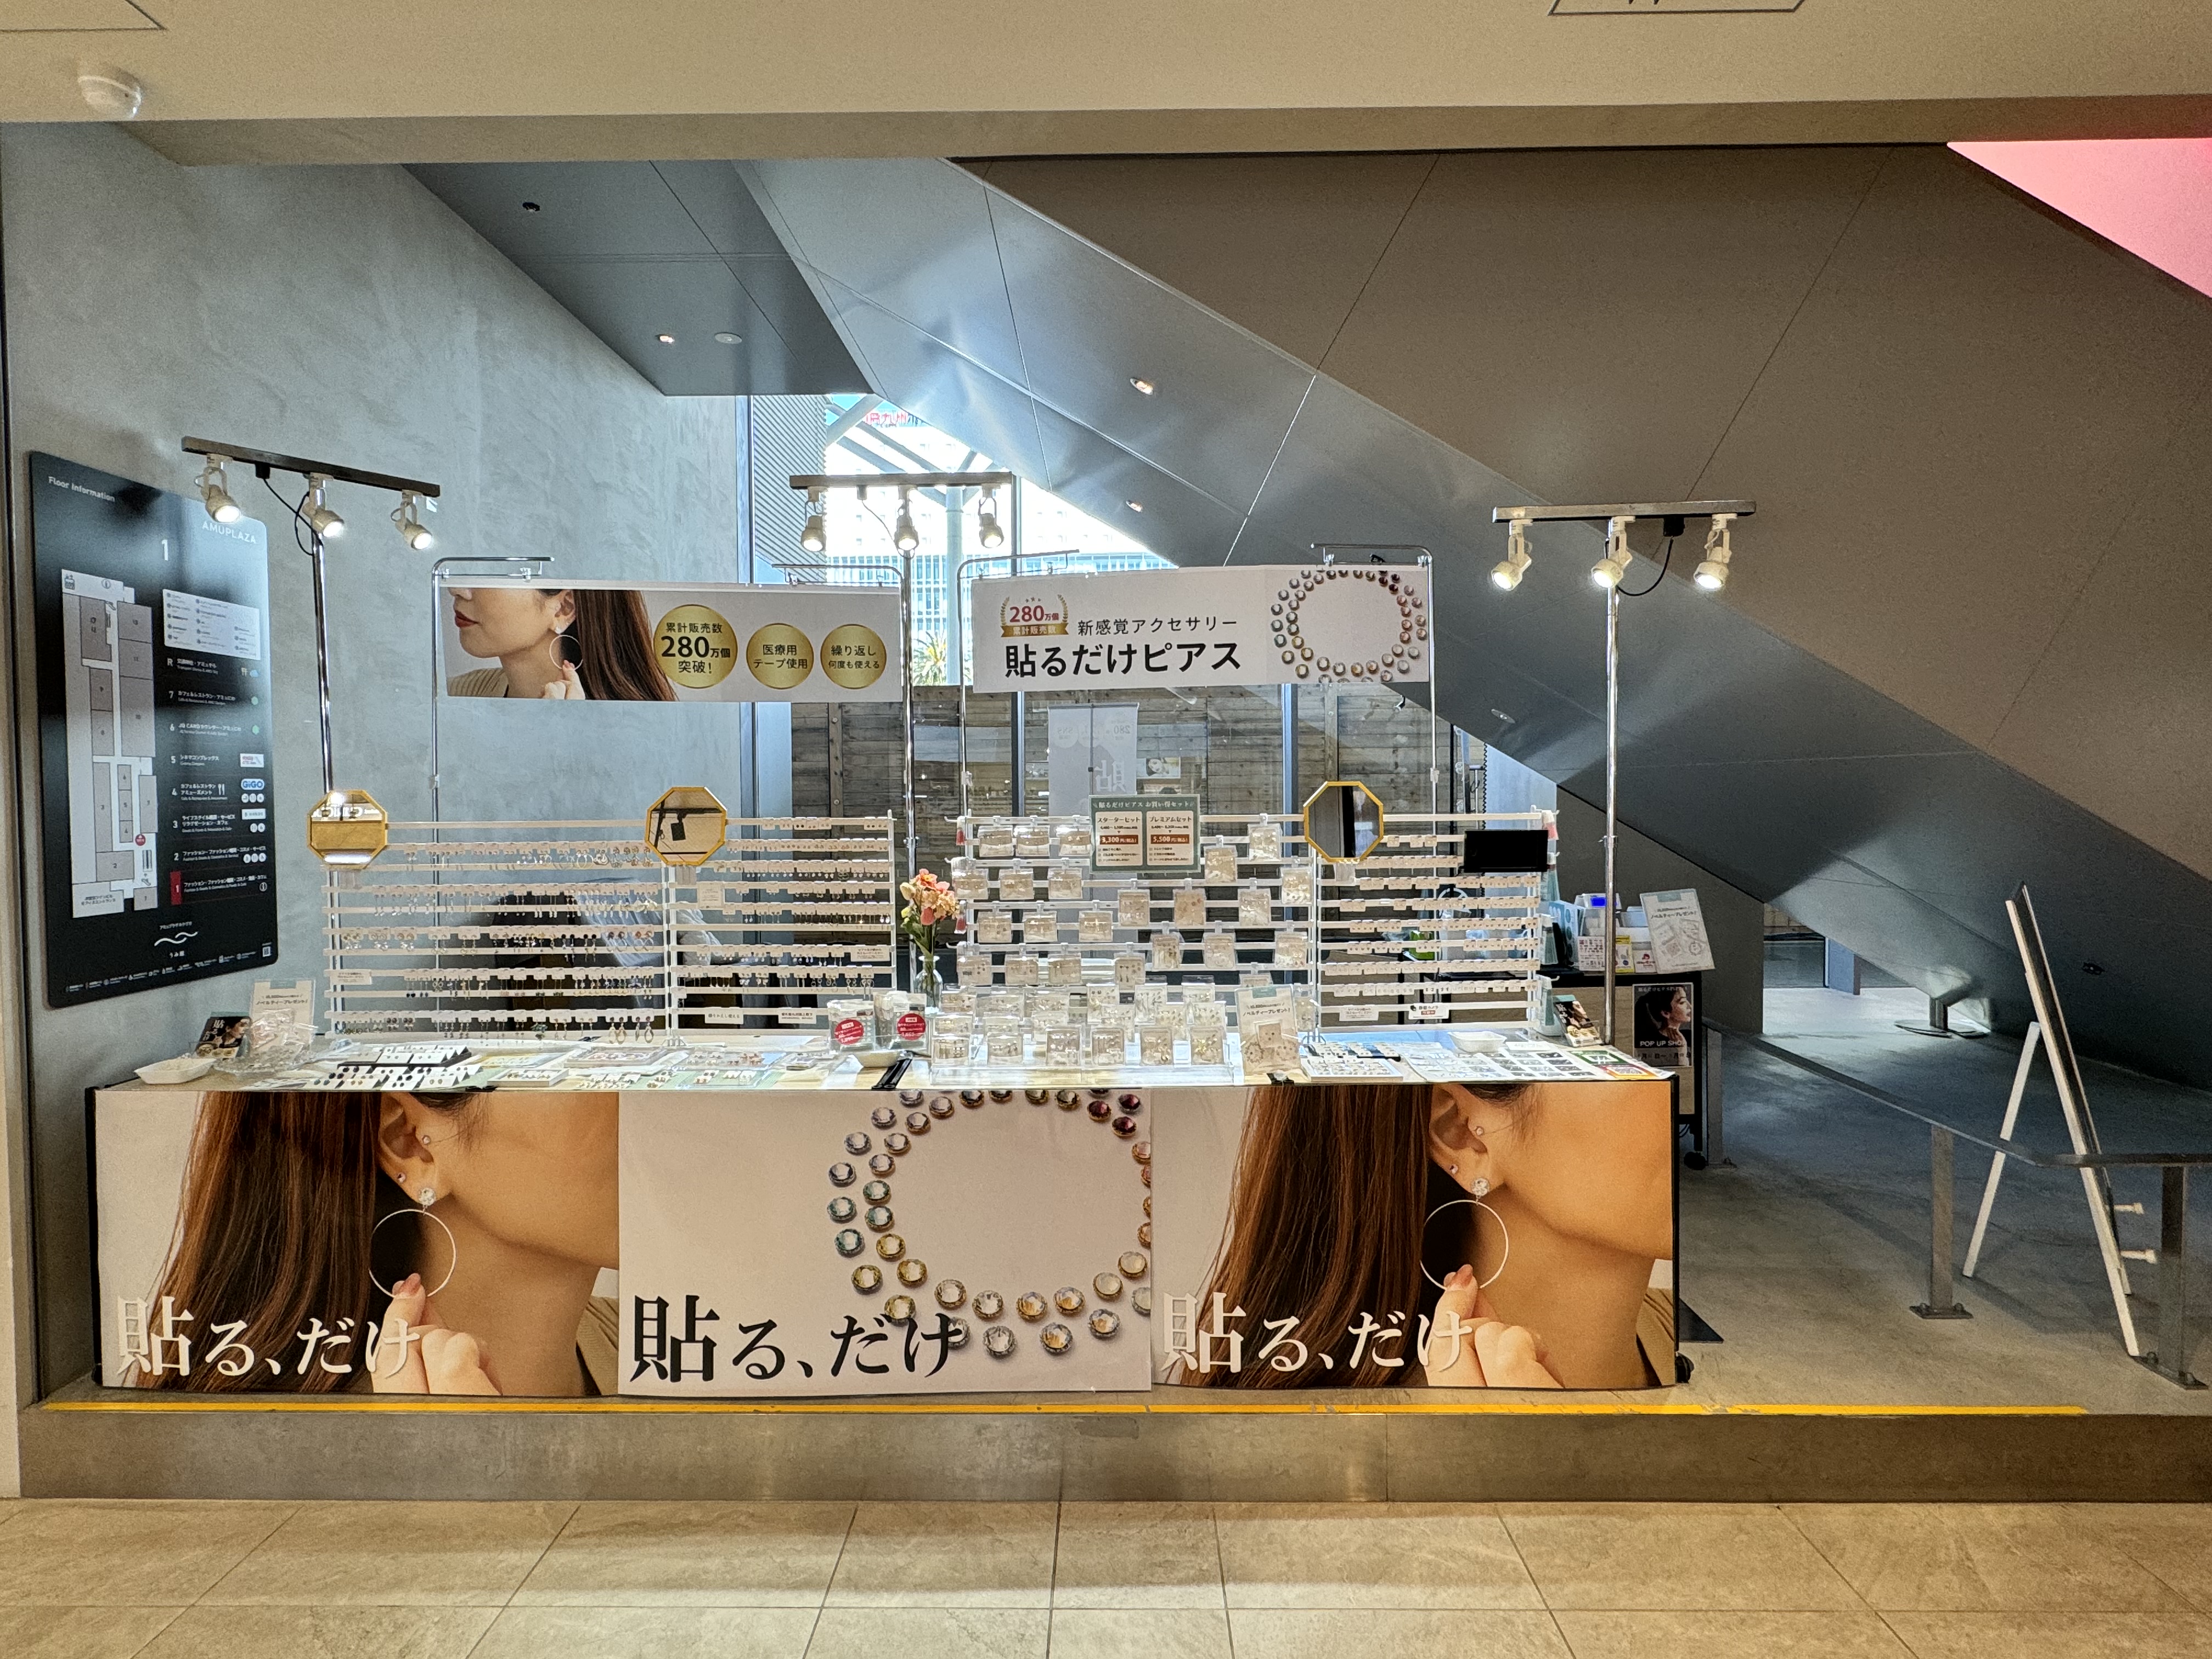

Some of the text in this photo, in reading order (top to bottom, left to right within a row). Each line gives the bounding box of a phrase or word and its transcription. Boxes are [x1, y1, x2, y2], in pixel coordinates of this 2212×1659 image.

[48, 476, 115, 503] Floor Information
[202, 521, 257, 544] AMUPLAZA
[161, 539, 169, 561] 1
[1009, 605, 1059, 623] 280万個
[665, 622, 723, 634] 累計販売数
[1013, 625, 1058, 636] 累計販売数
[1077, 616, 1238, 636] 新感覚アクセサリー
[661, 635, 731, 659] 280万個
[762, 644, 797, 656] 医療用
[831, 645, 877, 657] 繰り返し
[753, 659, 808, 670] テープ使用
[828, 660, 880, 670] 何度も使える
[1005, 642, 1242, 678] 貼るだけピアス
[678, 661, 713, 674] 突破！
[168, 691, 174, 699] 7
[171, 755, 176, 764] 5
[172, 820, 178, 828] 3
[173, 853, 179, 861] 2
[176, 884, 179, 893] 1
[116, 1295, 421, 1379] 貼る、だけ
[1161, 1291, 1473, 1374] 貼る、だけ
[629, 1294, 968, 1384] 貼る、だけ
